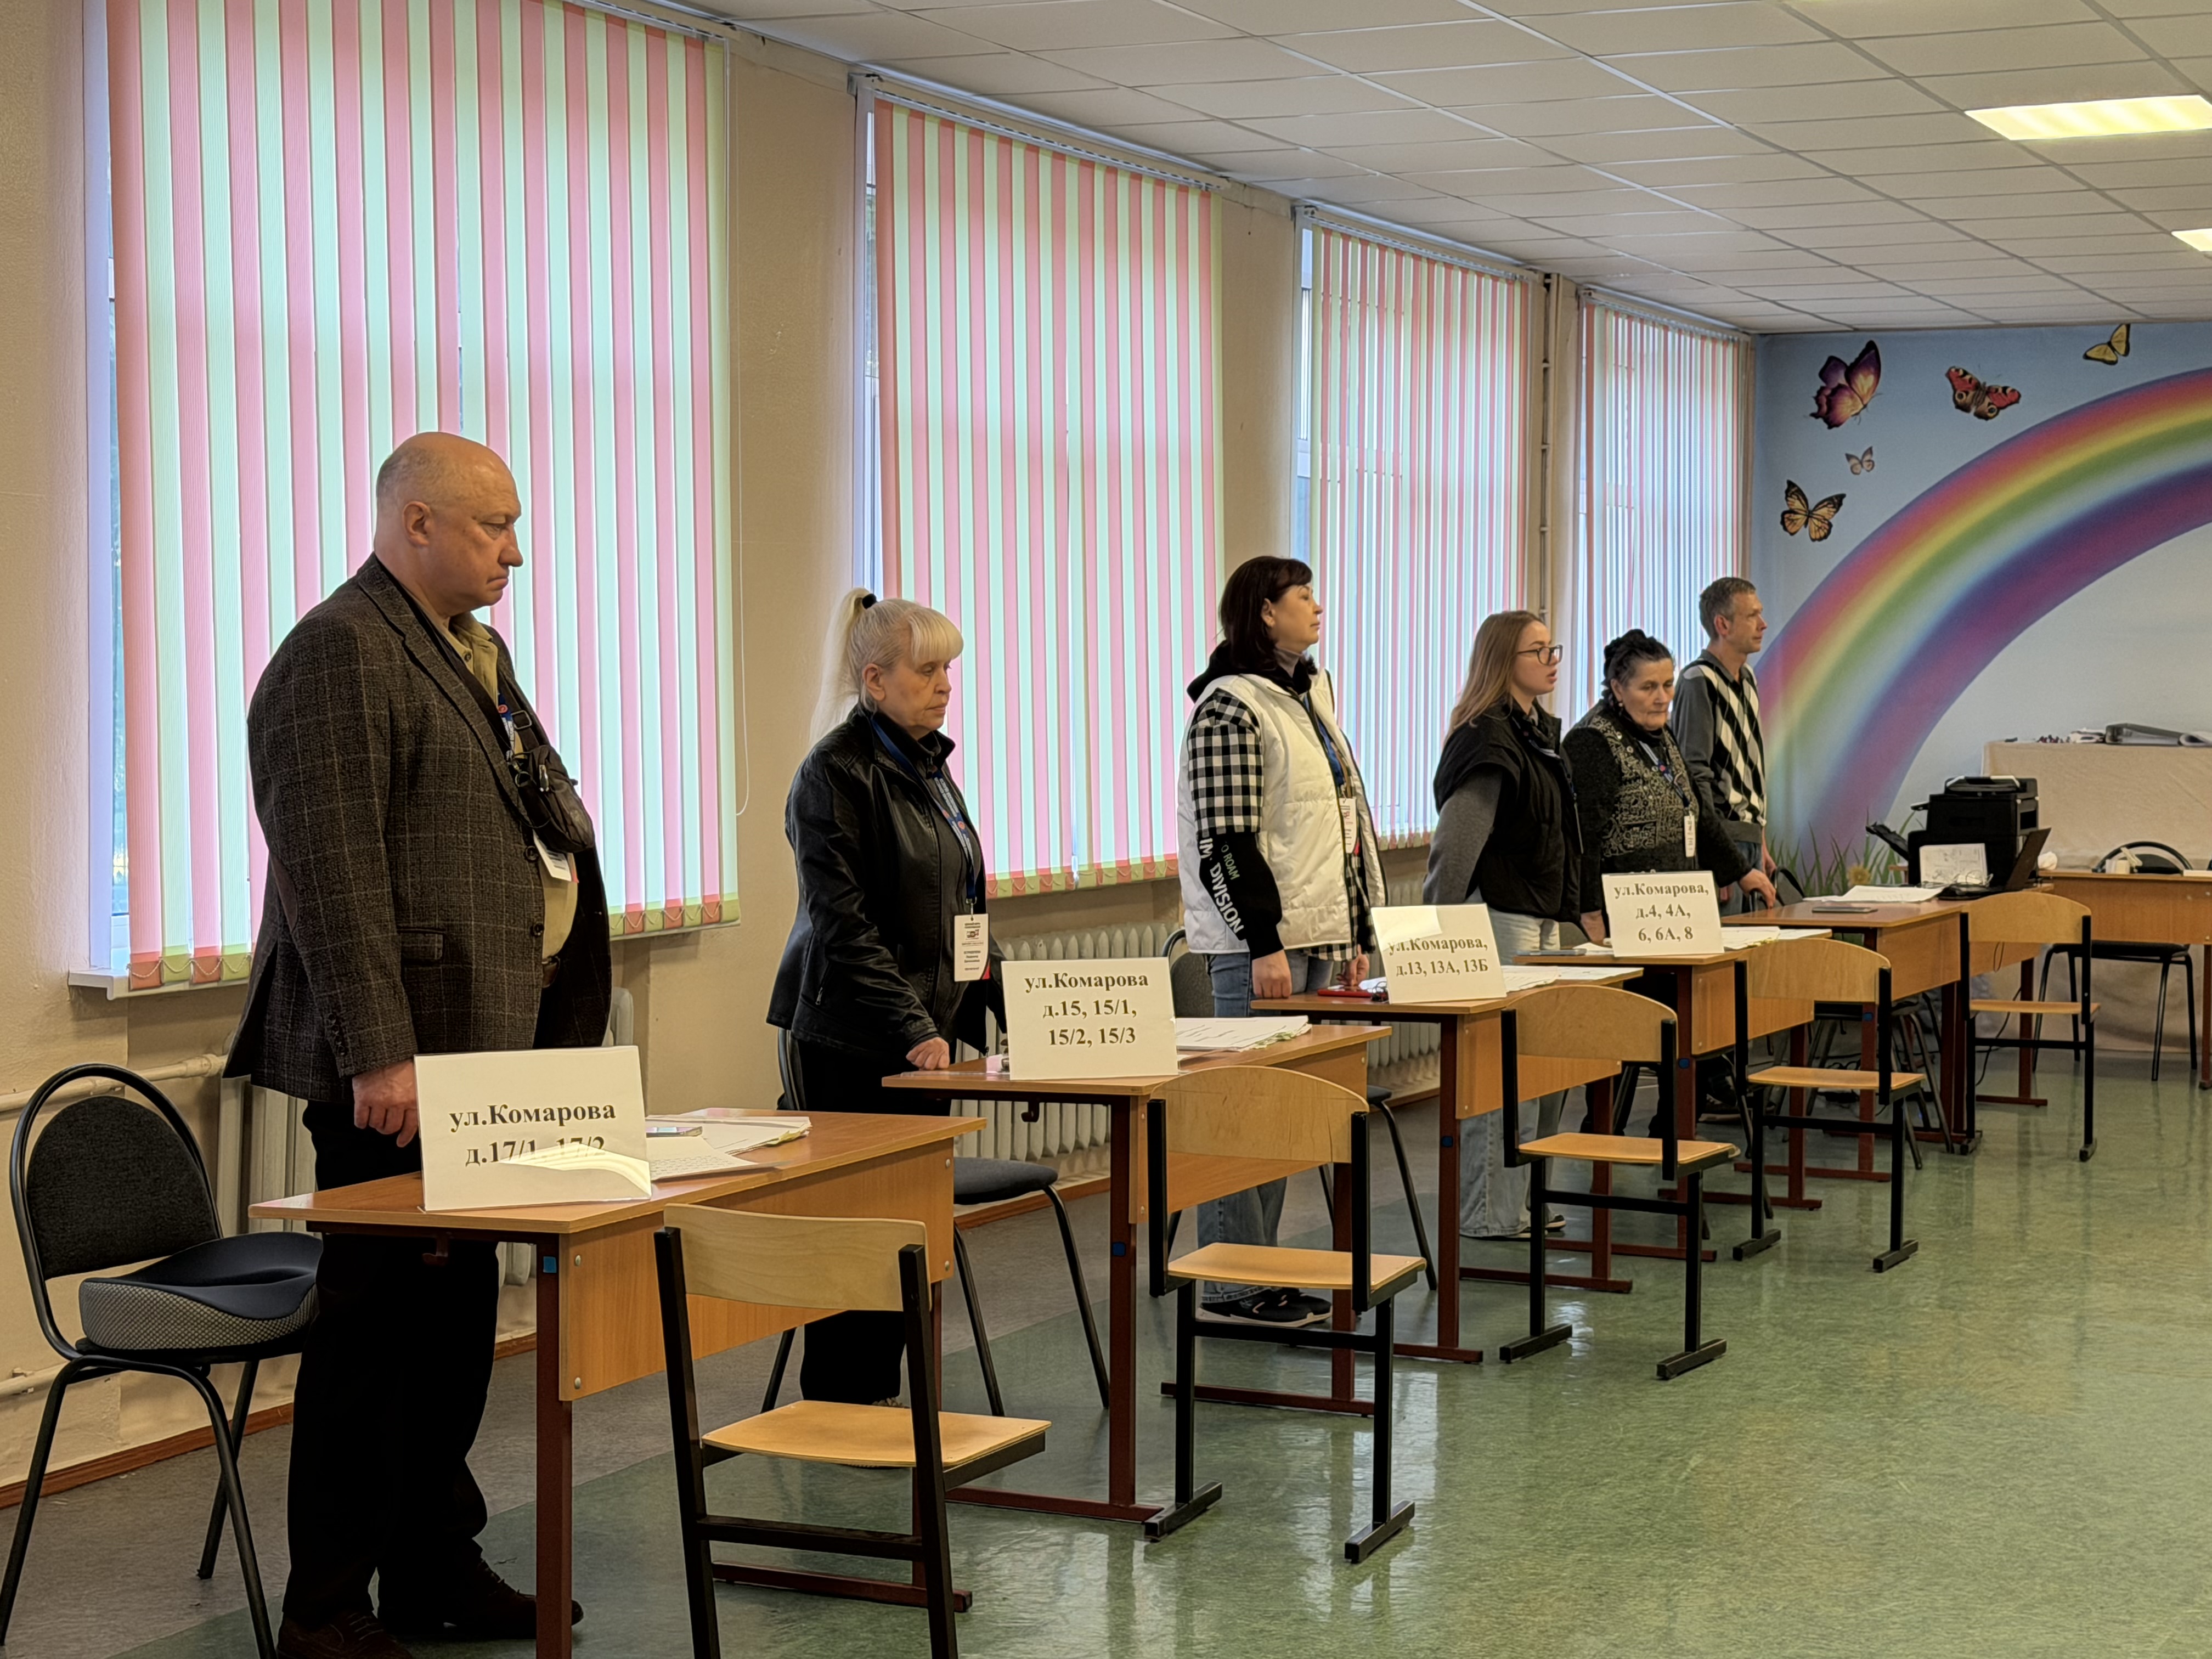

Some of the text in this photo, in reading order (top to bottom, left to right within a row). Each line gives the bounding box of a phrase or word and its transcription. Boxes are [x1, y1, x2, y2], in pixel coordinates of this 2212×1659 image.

[1223, 852, 1240, 881] ROAM
[1209, 861, 1245, 934] DIVISION
[1613, 882, 1709, 899] ул.Комарова,
[1635, 904, 1691, 919] д.4, 4А,
[1638, 926, 1694, 943] 6, 6А, 8
[1387, 938, 1488, 956] ул.Комарова,
[1396, 958, 1488, 977] д.13, 13А, 13Б
[1024, 972, 1149, 994] ул.Комарова
[1042, 999, 1137, 1019] д.15, 15/1,
[1049, 1027, 1136, 1048] 15/2, 15/3
[449, 1103, 617, 1133] ул.Комарова
